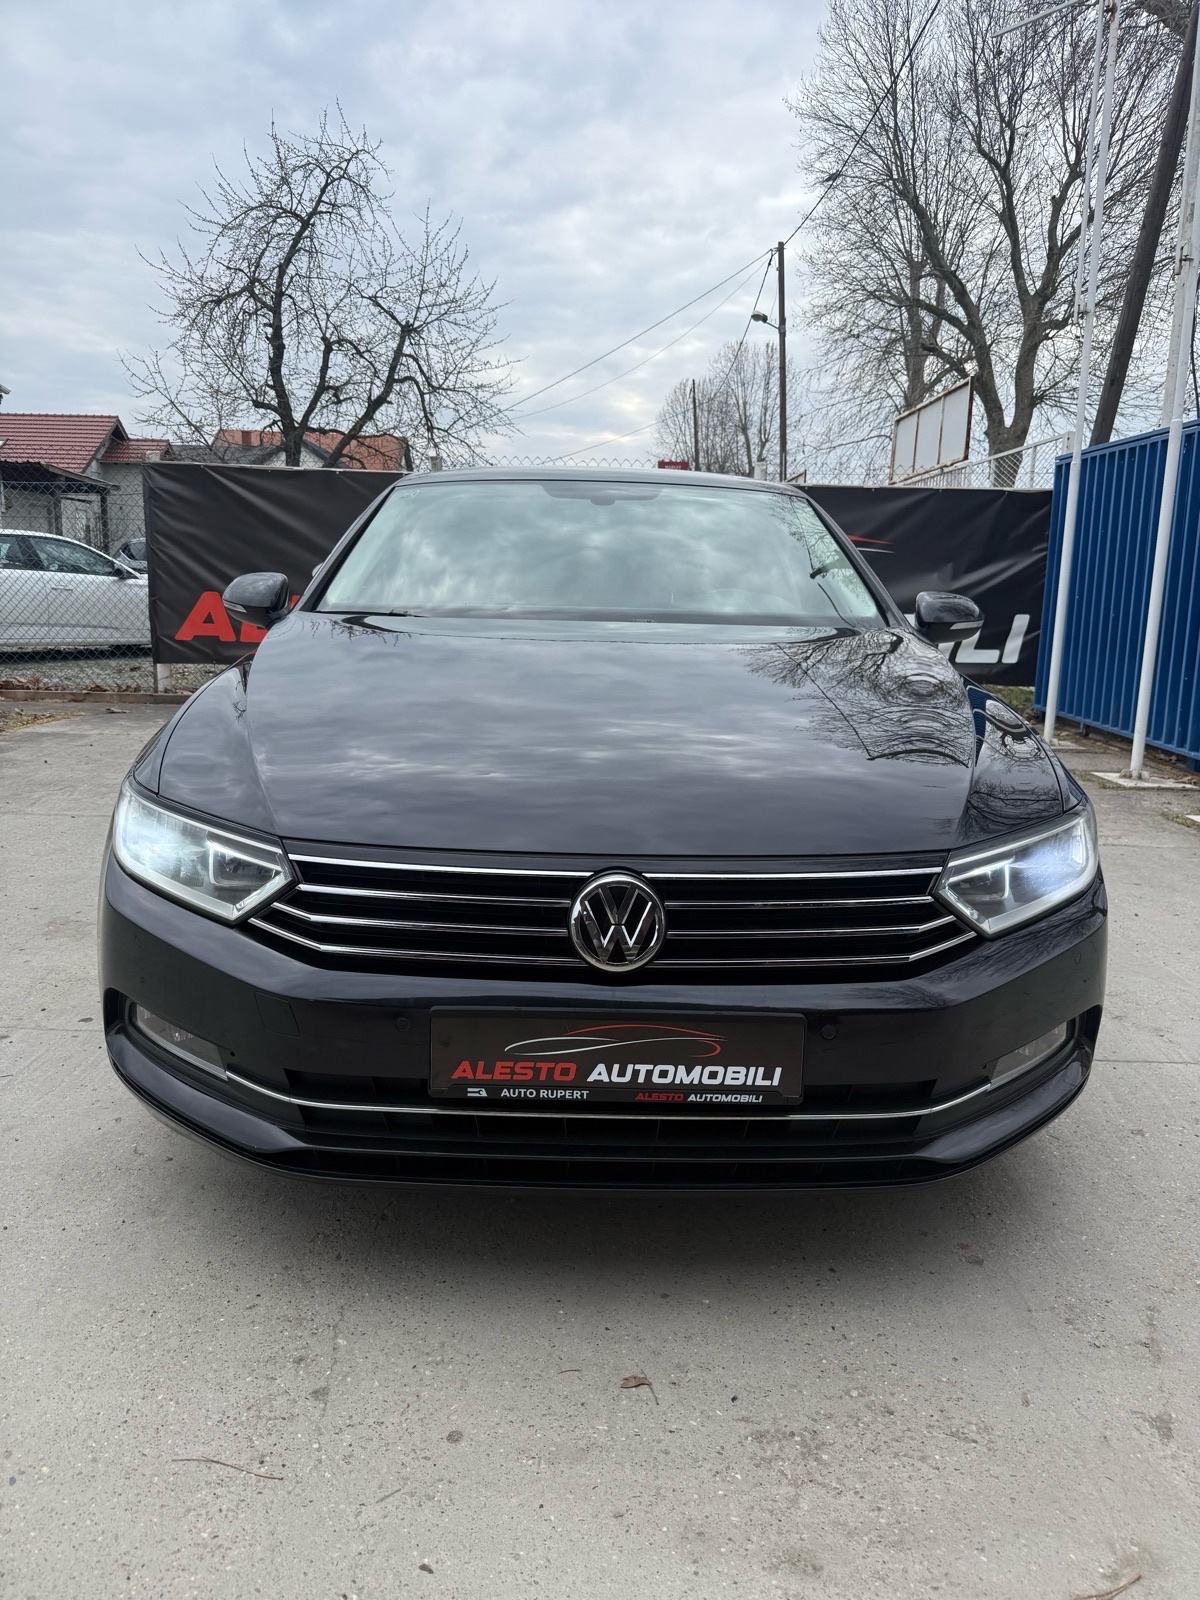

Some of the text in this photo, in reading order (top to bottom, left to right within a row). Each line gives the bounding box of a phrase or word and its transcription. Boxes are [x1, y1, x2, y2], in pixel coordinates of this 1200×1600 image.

[451, 1060, 782, 1086] ALESTO AUTOMOBILI
[500, 1088, 589, 1099] AUTO RUPERT
[635, 1093, 763, 1103] ALESTO AUTOMOBILI
